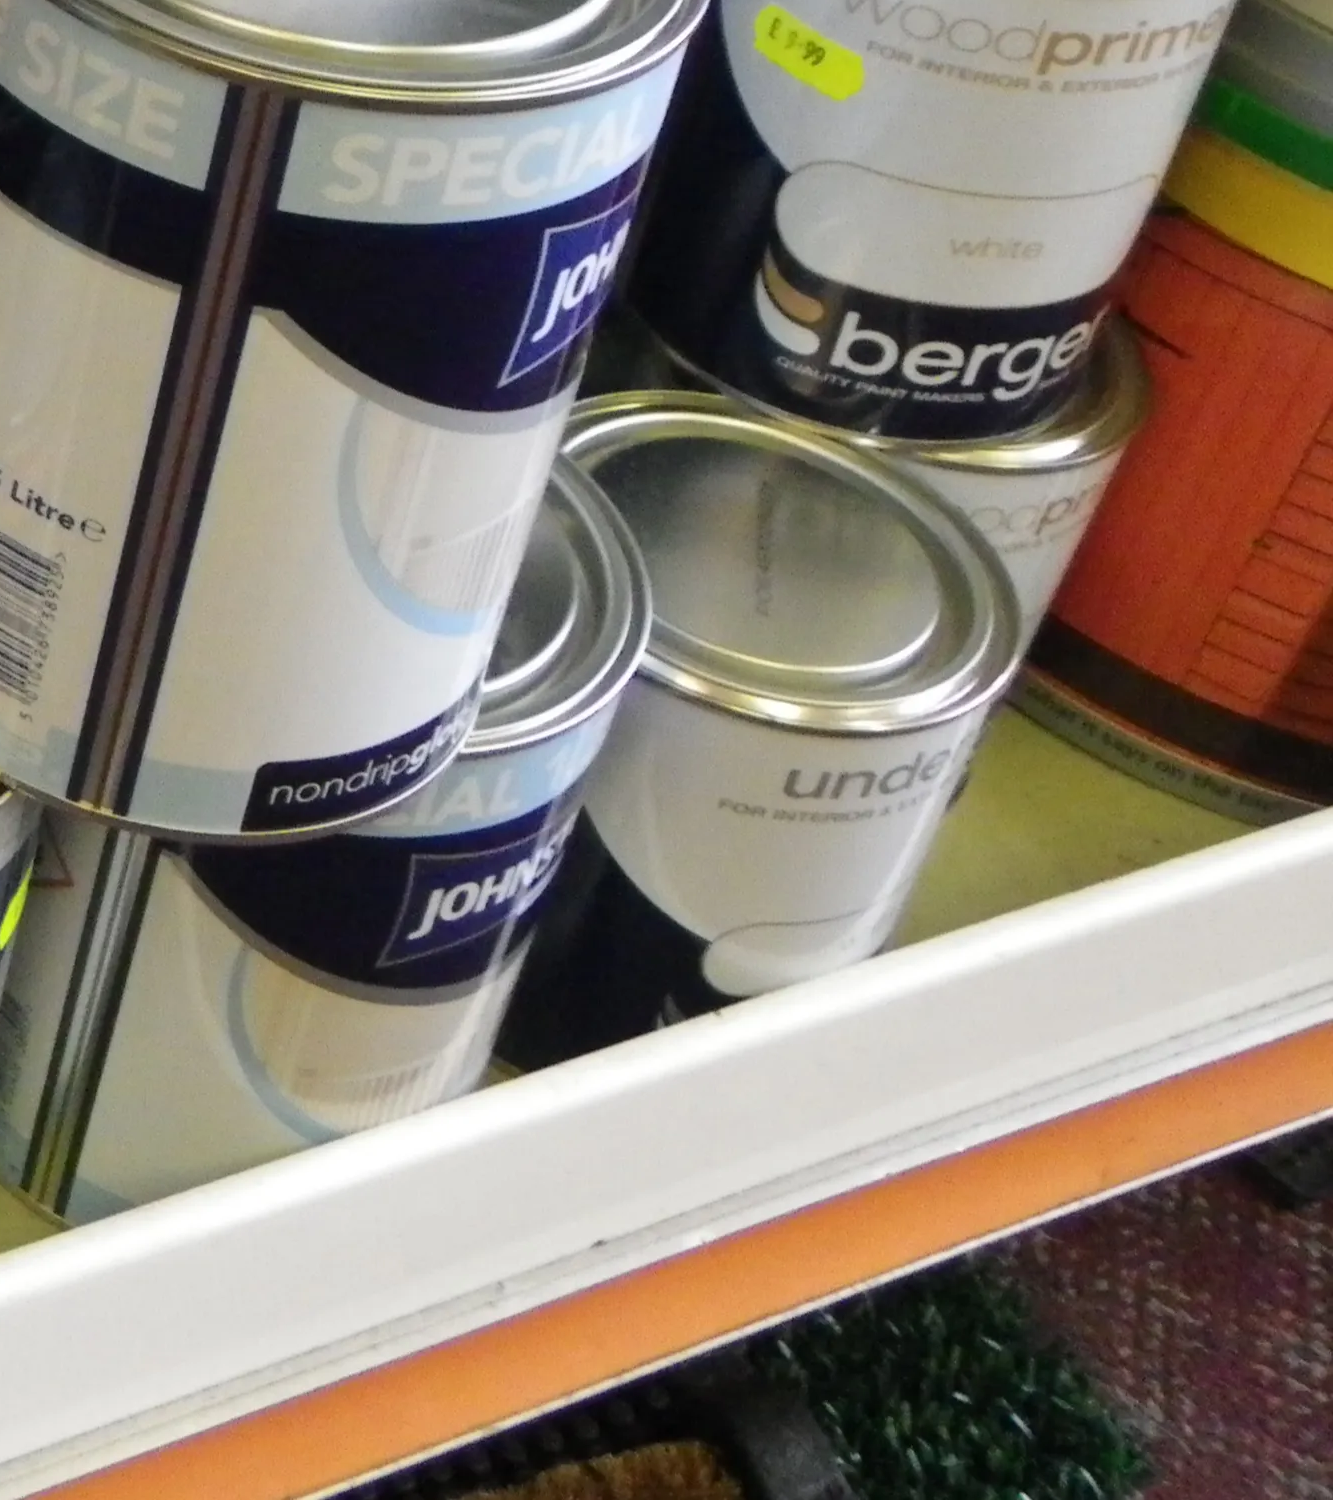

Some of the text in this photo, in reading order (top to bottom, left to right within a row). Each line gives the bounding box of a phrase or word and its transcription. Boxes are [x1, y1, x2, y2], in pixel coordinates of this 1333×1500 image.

[866, 40, 913, 65] FOR
[917, 60, 1030, 91] INTERIOR
[20, 19, 643, 206] SIZE SPECIAL
[949, 234, 1044, 260] white
[9, 479, 76, 531] Litre
[717, 797, 769, 821] FOR
